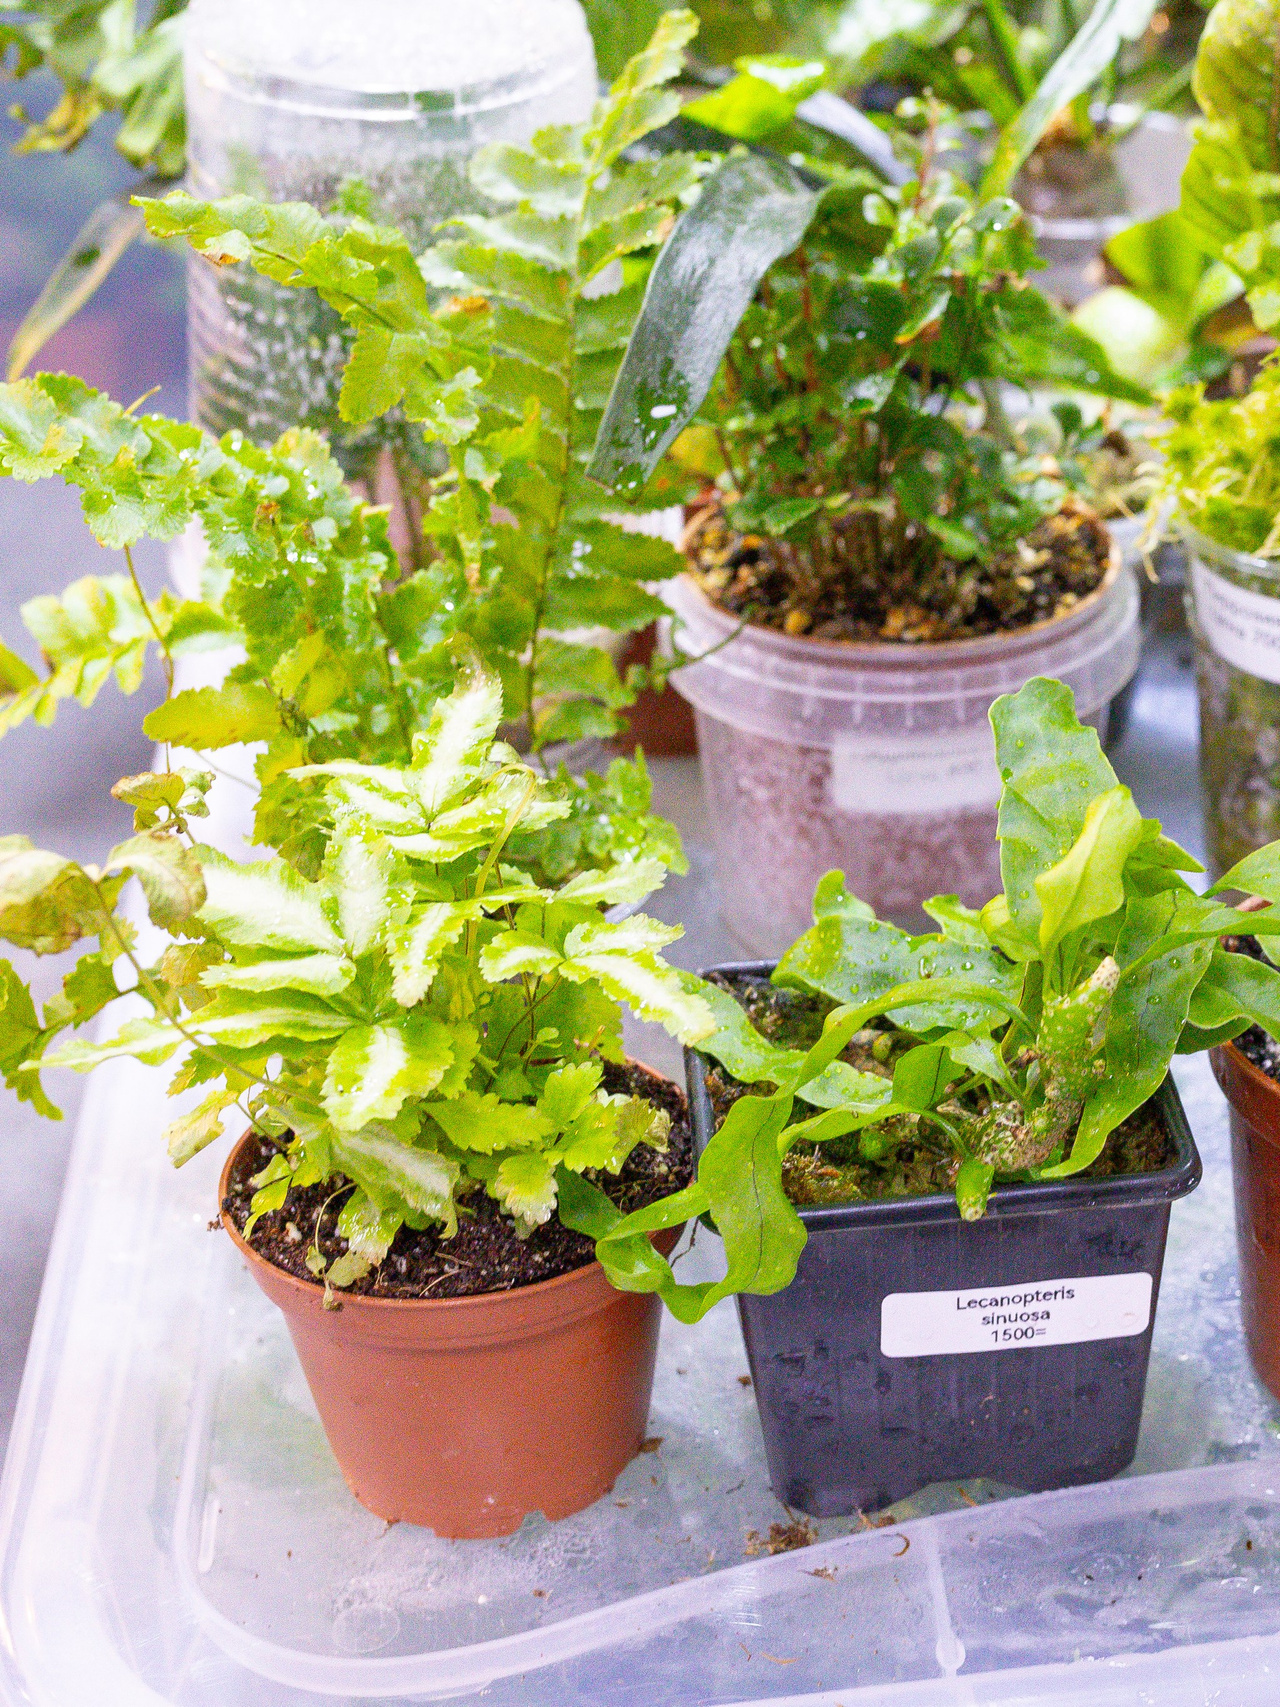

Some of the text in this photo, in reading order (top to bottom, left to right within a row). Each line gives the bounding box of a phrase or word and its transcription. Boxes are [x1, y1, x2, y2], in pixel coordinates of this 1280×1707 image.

[956, 1286, 1076, 1311] Lecanopteris
[981, 1309, 1051, 1326] sinuosa
[991, 1326, 1048, 1344] 1500=
